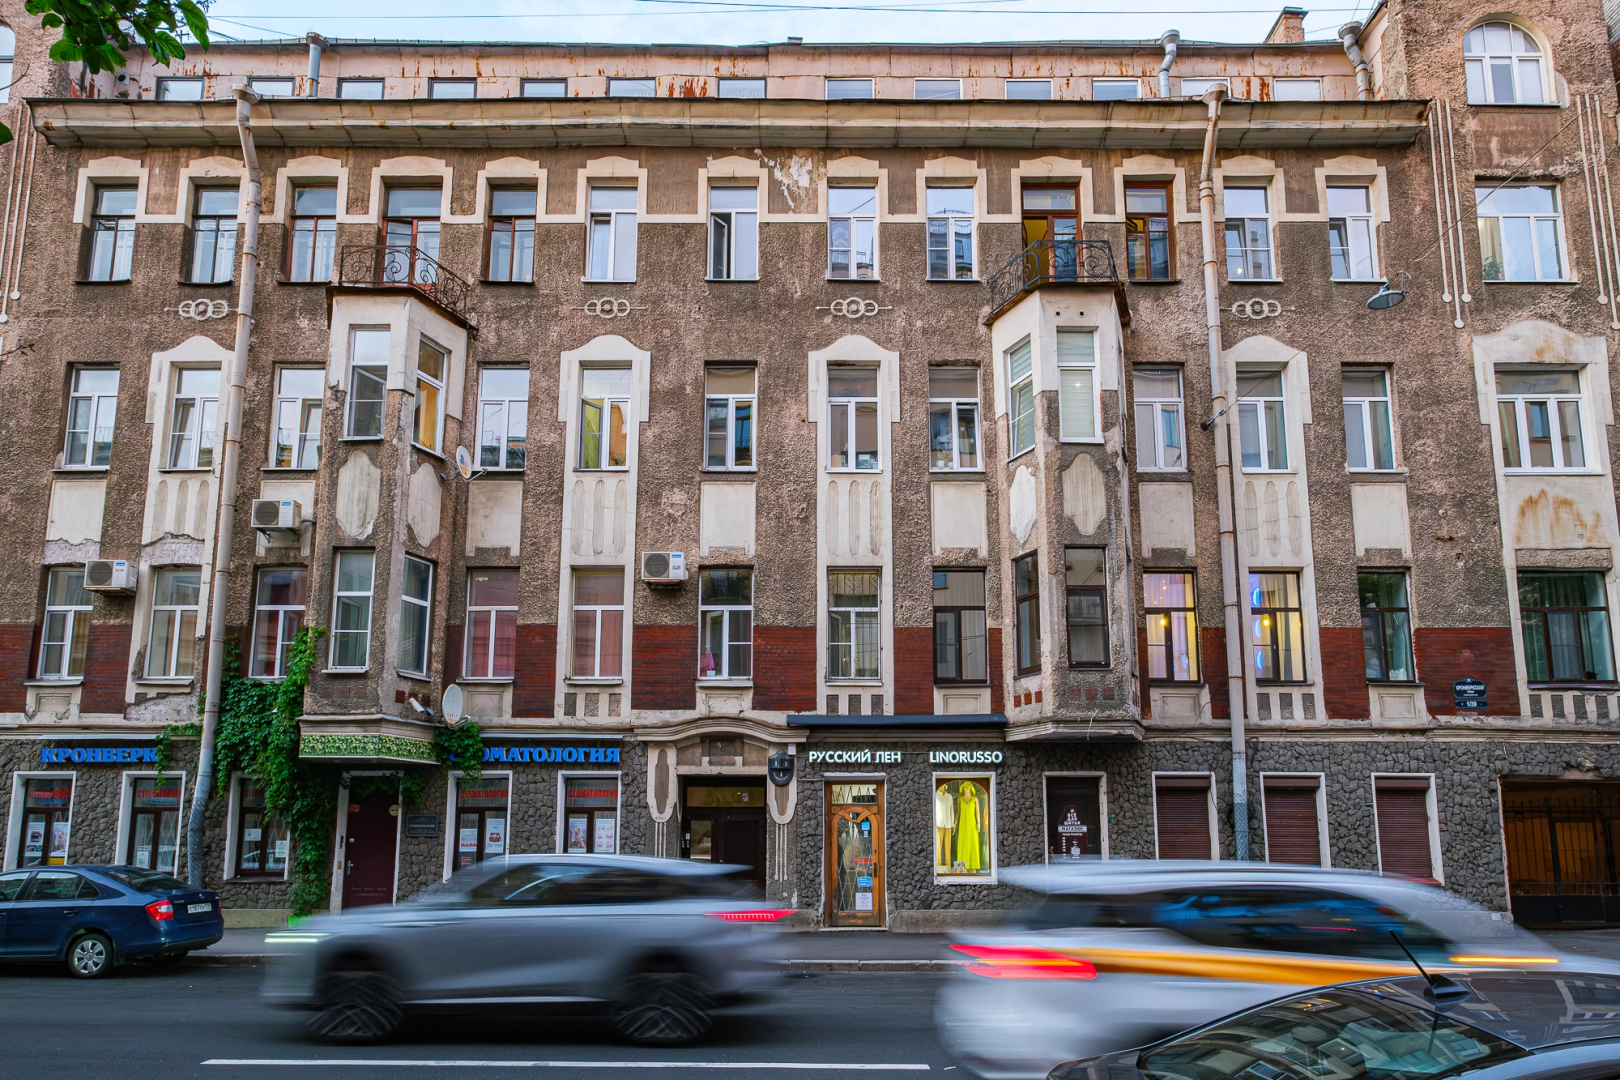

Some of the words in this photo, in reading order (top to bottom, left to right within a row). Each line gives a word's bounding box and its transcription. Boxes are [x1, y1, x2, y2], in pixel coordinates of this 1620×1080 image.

[40, 747, 159, 763] КРОНВЕРК
[449, 746, 621, 763] СОМАТОЛОГИЯ
[808, 748, 872, 764] РУССКИЙ
[874, 750, 902, 764] ЛЕН
[929, 750, 1003, 764] LINORUSSO
